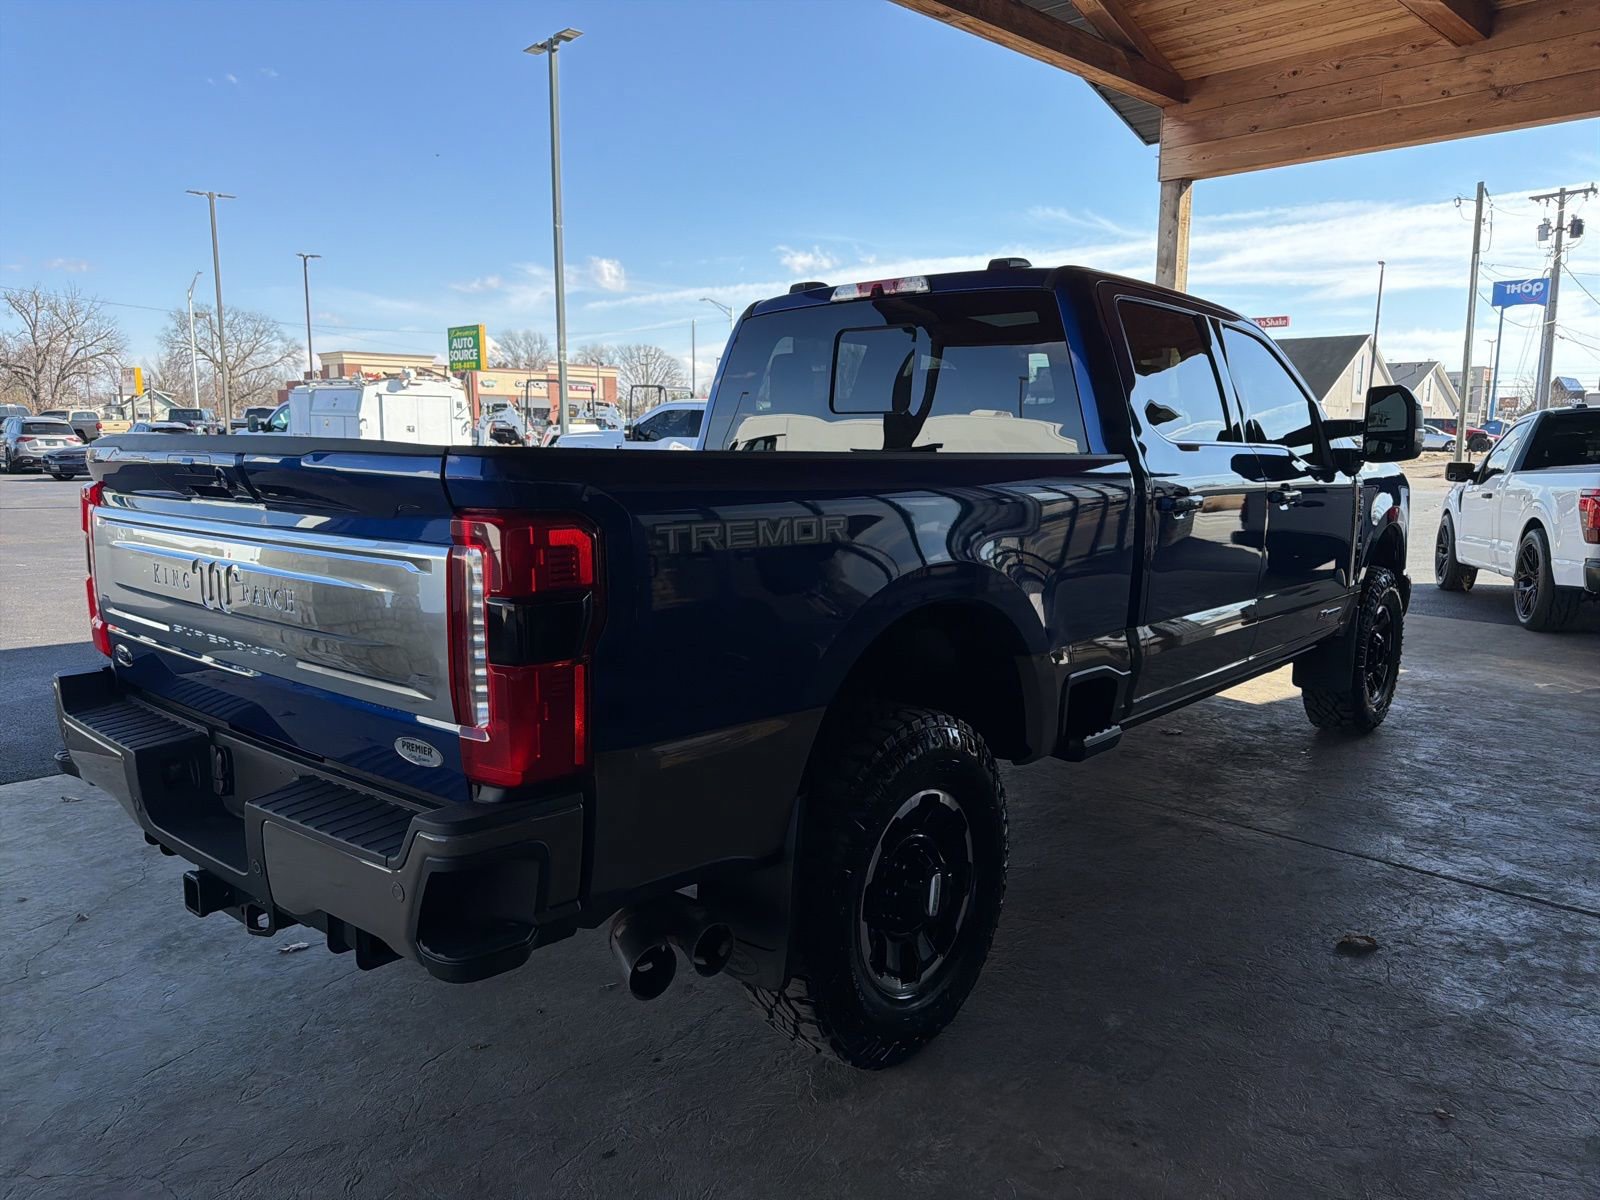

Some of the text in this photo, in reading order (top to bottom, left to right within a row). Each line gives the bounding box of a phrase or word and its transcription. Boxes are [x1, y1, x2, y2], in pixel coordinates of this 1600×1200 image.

[1506, 281, 1544, 296] IHOP
[1266, 317, 1287, 326] Shake
[452, 337, 474, 349] AUTO
[450, 349, 478, 361] SOURCE
[655, 516, 848, 554] TREMOR
[153, 563, 190, 589] KING
[241, 583, 296, 614] RANCH
[401, 740, 433, 758] PREMIER
